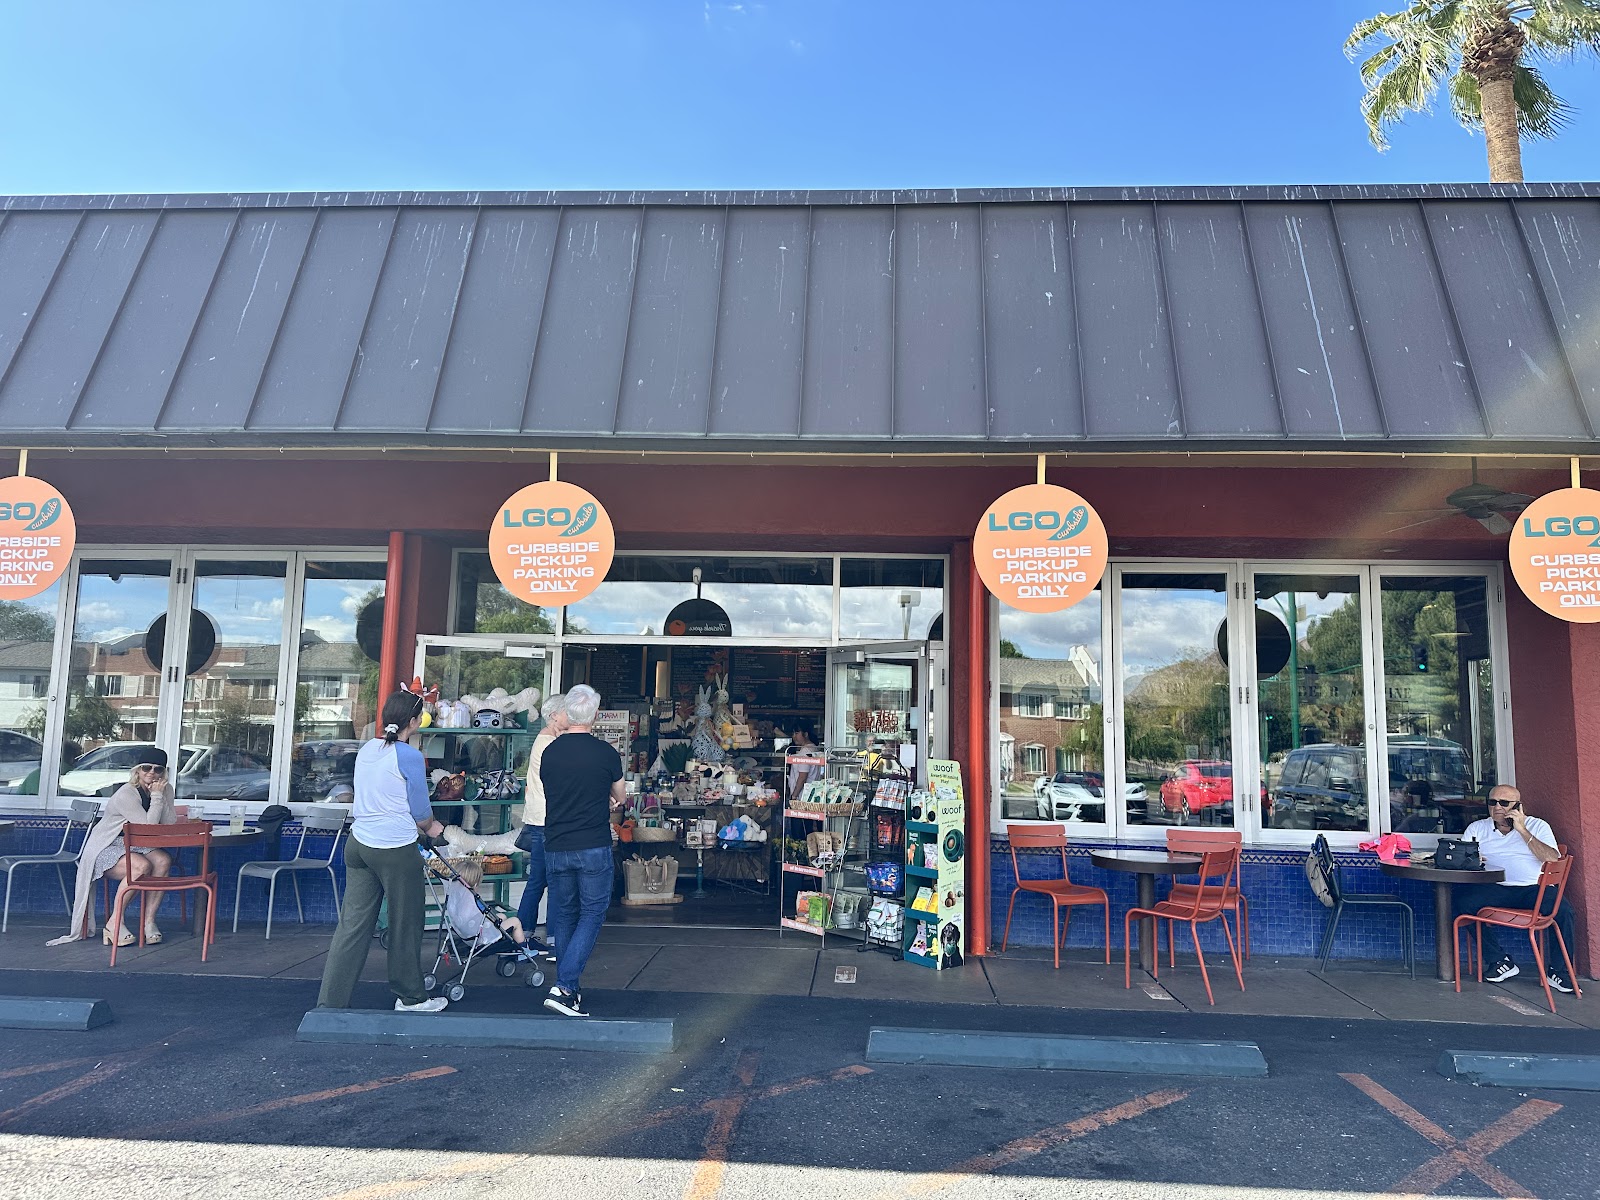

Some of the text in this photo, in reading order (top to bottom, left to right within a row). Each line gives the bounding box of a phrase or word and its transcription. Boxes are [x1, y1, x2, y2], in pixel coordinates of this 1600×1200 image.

[0, 500, 58, 529] GO curbside
[503, 505, 594, 535] LGO curbside
[988, 508, 1085, 539] LGO curbside
[1523, 516, 1600, 538] LGO
[0, 536, 61, 547] RBSIDE
[507, 541, 600, 555] CURBSIDE
[0, 549, 48, 559] CKUP
[992, 545, 1092, 559] CURBSIDE
[0, 561, 54, 572] RKING
[520, 554, 587, 567] PICKUP
[1006, 559, 1079, 571] PICKUP
[1530, 553, 1600, 567] CURBS
[0, 573, 37, 585] NLY
[513, 566, 594, 579] PARKING
[999, 571, 1087, 584] PARKING
[529, 579, 578, 592] ONLY
[1017, 584, 1069, 597] ONLY
[1539, 580, 1600, 593] PARKI
[1559, 594, 1600, 606] ONL
[933, 763, 954, 773] woof
[941, 803, 962, 815] woof
